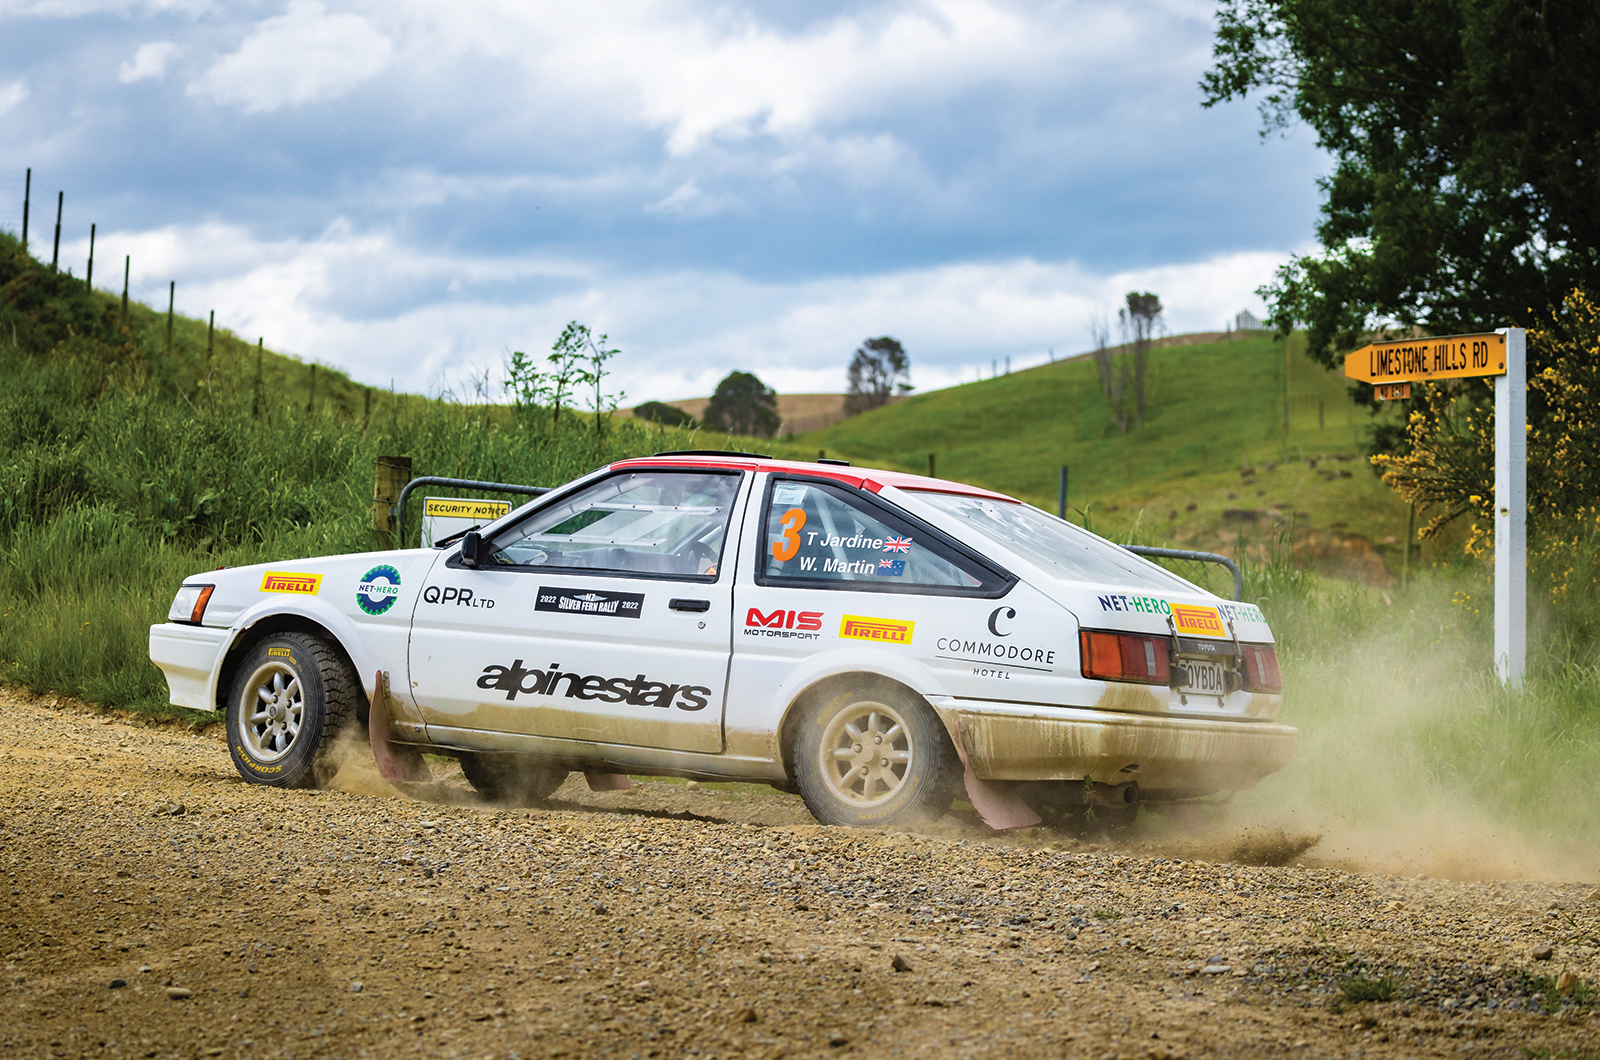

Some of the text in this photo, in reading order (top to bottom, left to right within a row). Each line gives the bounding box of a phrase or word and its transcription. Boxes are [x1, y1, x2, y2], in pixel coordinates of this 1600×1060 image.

[1370, 341, 1488, 376] LIMESTONE HILLS RD
[428, 504, 507, 516] SECURITY NOTICE
[772, 508, 807, 562] 3
[807, 531, 883, 550] T Jardine
[800, 556, 875, 574] W. Martin
[264, 576, 317, 592] PIRELLI
[358, 584, 399, 594] NET-HERO
[423, 586, 495, 609] QPR LTD
[540, 595, 639, 613] 2022 SILVER FERN RALLY 2022
[1098, 595, 1171, 615] NET-HERO
[1175, 608, 1220, 630] PIRELLI
[743, 628, 820, 640] MOTORSPORT
[844, 620, 908, 641] PIRELLI
[936, 637, 1055, 664] COMMODORE
[1197, 643, 1216, 652] TOYOTA
[972, 668, 1010, 680] HOTEL
[1180, 663, 1222, 691] OYBDA
[476, 658, 712, 712] alpinestars
